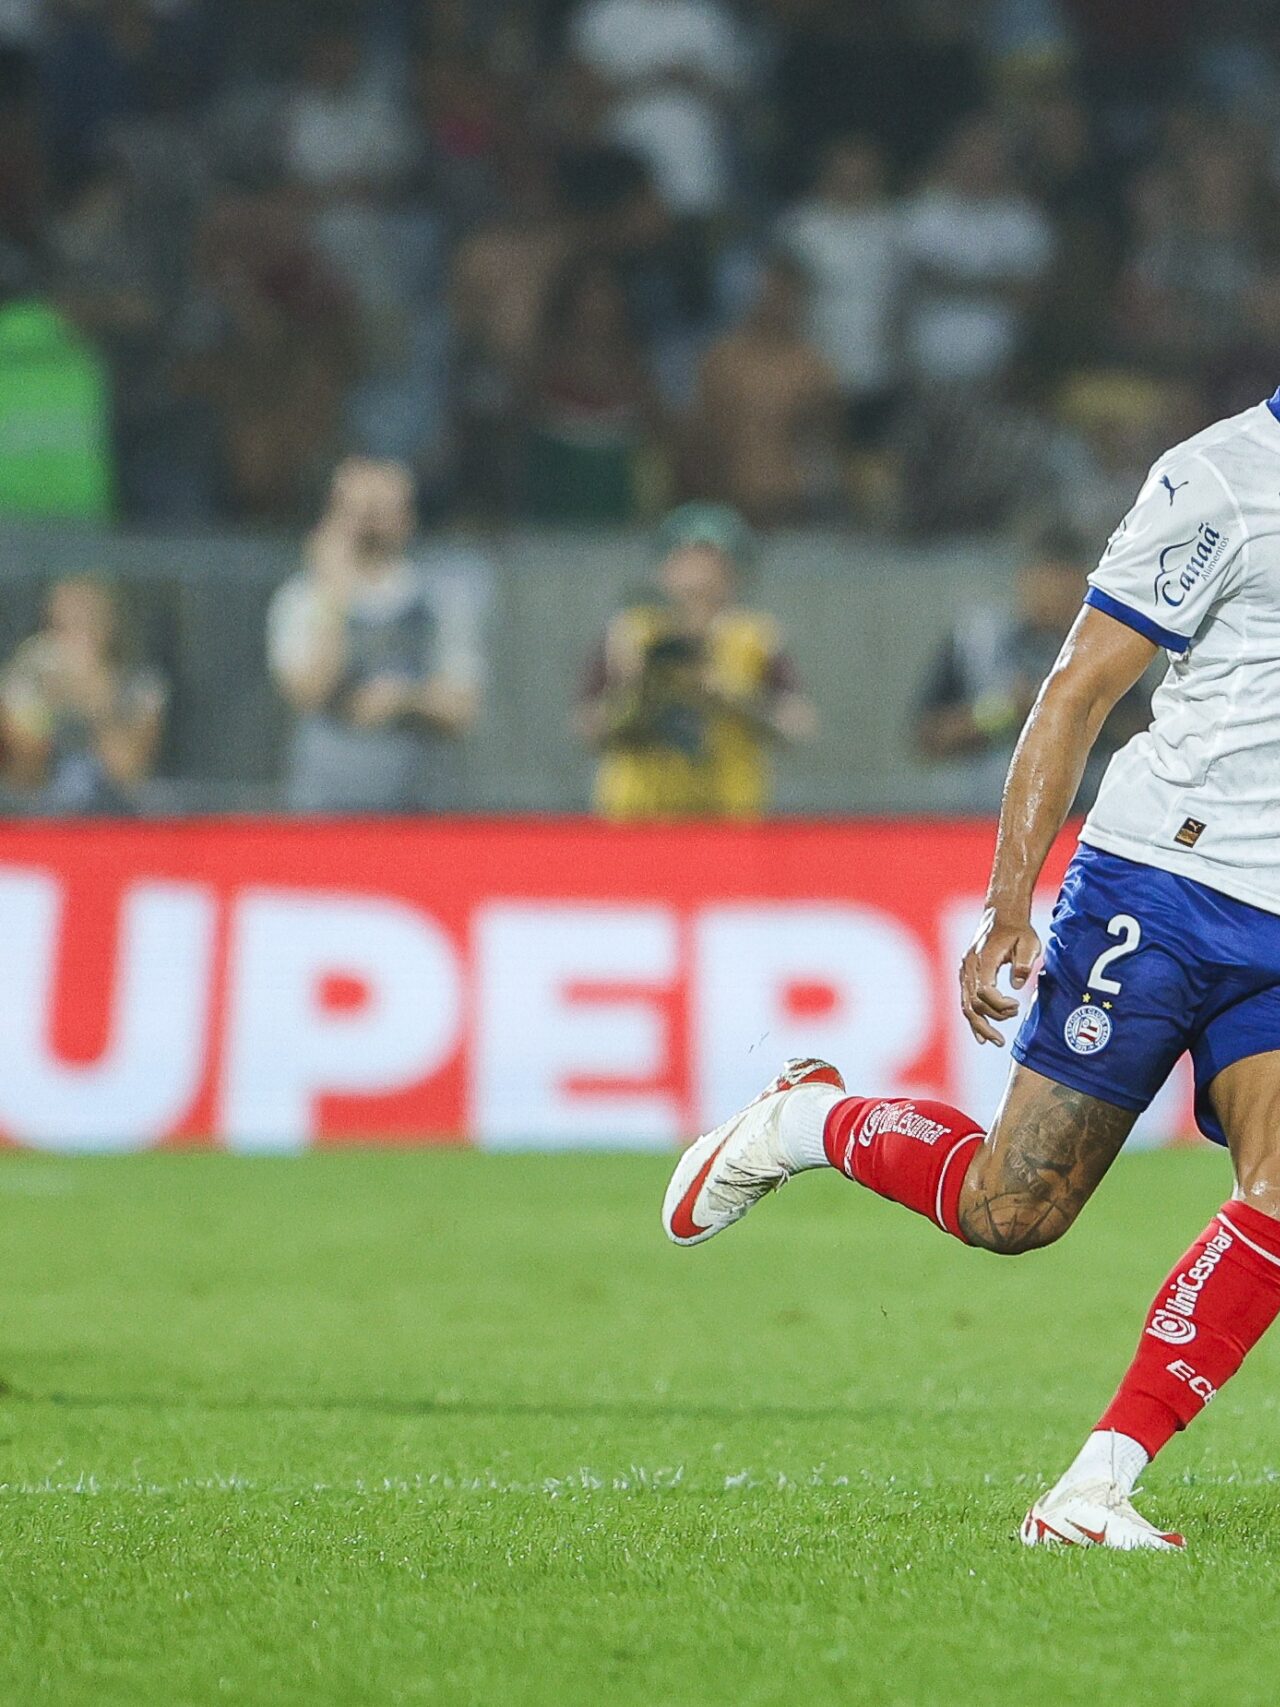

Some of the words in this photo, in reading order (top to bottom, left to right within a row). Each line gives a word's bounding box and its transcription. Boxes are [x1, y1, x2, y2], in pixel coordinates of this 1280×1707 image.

[1161, 522, 1220, 607] Canaã
[1201, 536, 1229, 581] Alimentos
[1087, 914, 1141, 996] 2
